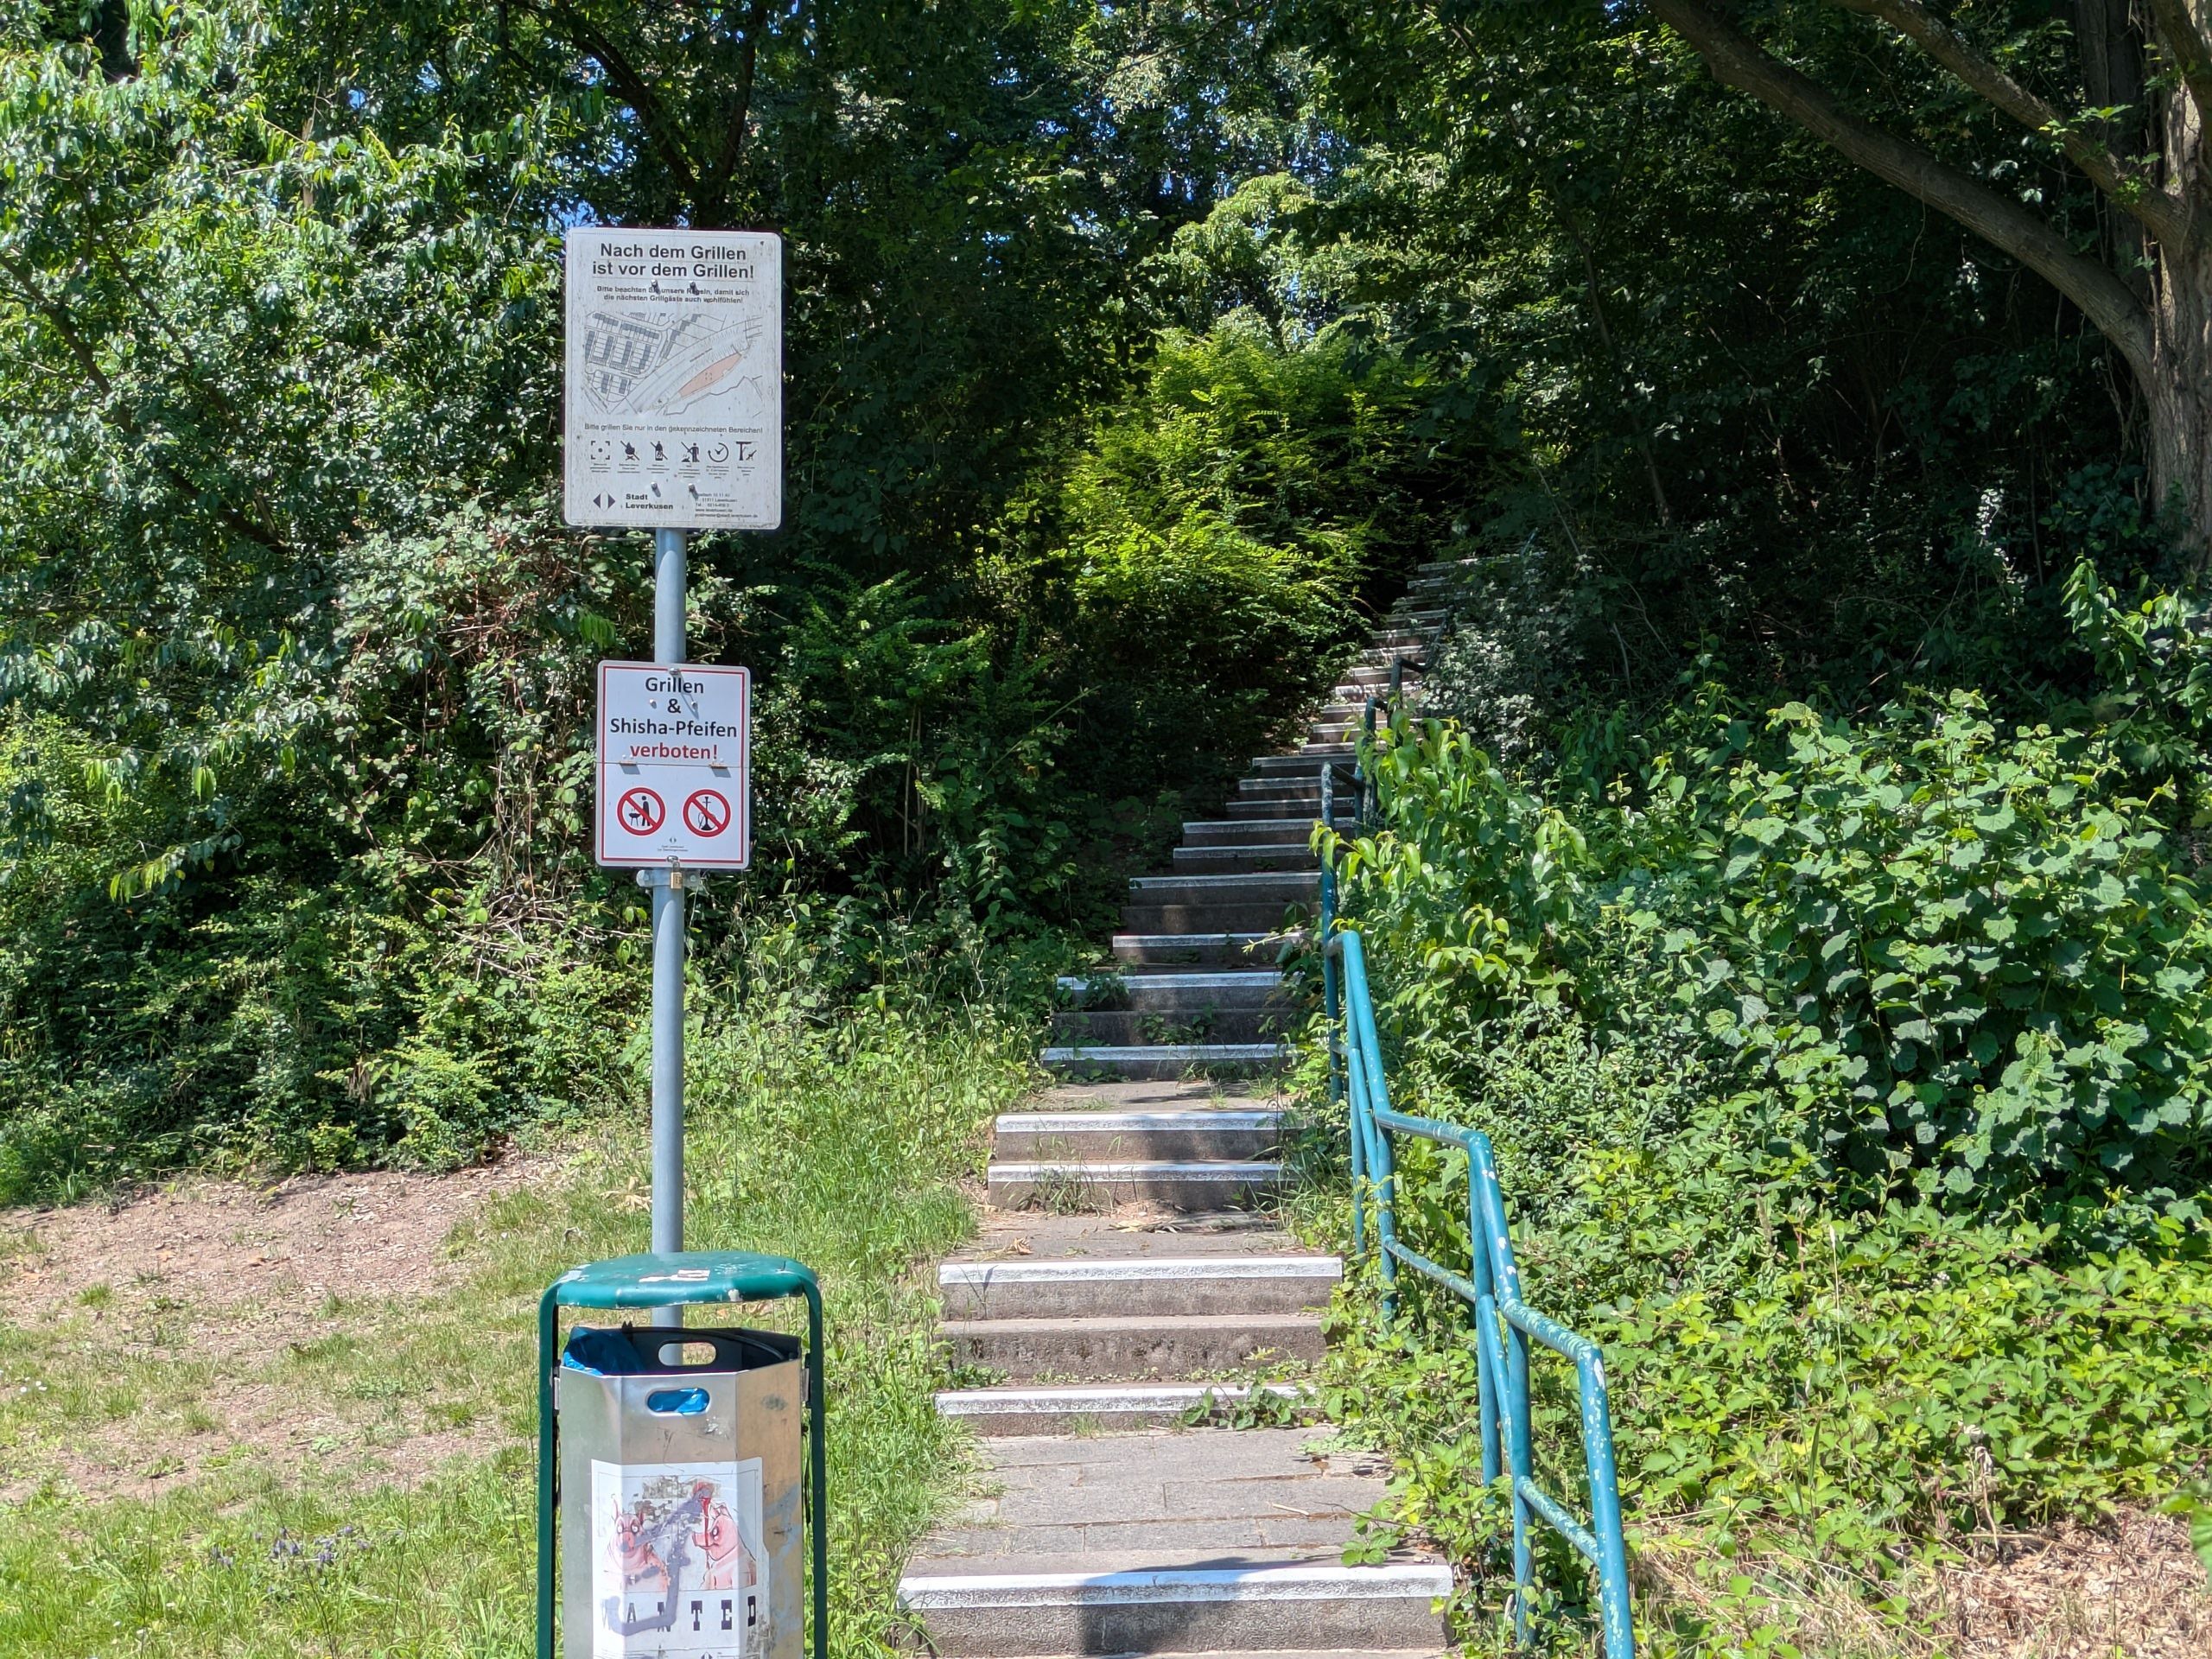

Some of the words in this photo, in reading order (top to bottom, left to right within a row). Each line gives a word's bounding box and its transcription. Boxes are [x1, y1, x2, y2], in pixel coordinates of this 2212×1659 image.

[601, 243, 644, 257] Nach
[649, 245, 685, 258] dem
[690, 245, 747, 260] Grillen
[593, 261, 613, 275] ist
[619, 264, 646, 276] vor
[651, 263, 687, 276] dem
[693, 264, 754, 278] Grillen!
[650, 295, 683, 303] Grillgäste
[687, 288, 713, 296] Rgeln,
[601, 423, 620, 432] grillen
[645, 677, 704, 694] Grillen
[667, 698, 682, 714] &
[610, 718, 737, 738] Shisha-Pfeifen
[630, 743, 718, 759] verboten!
